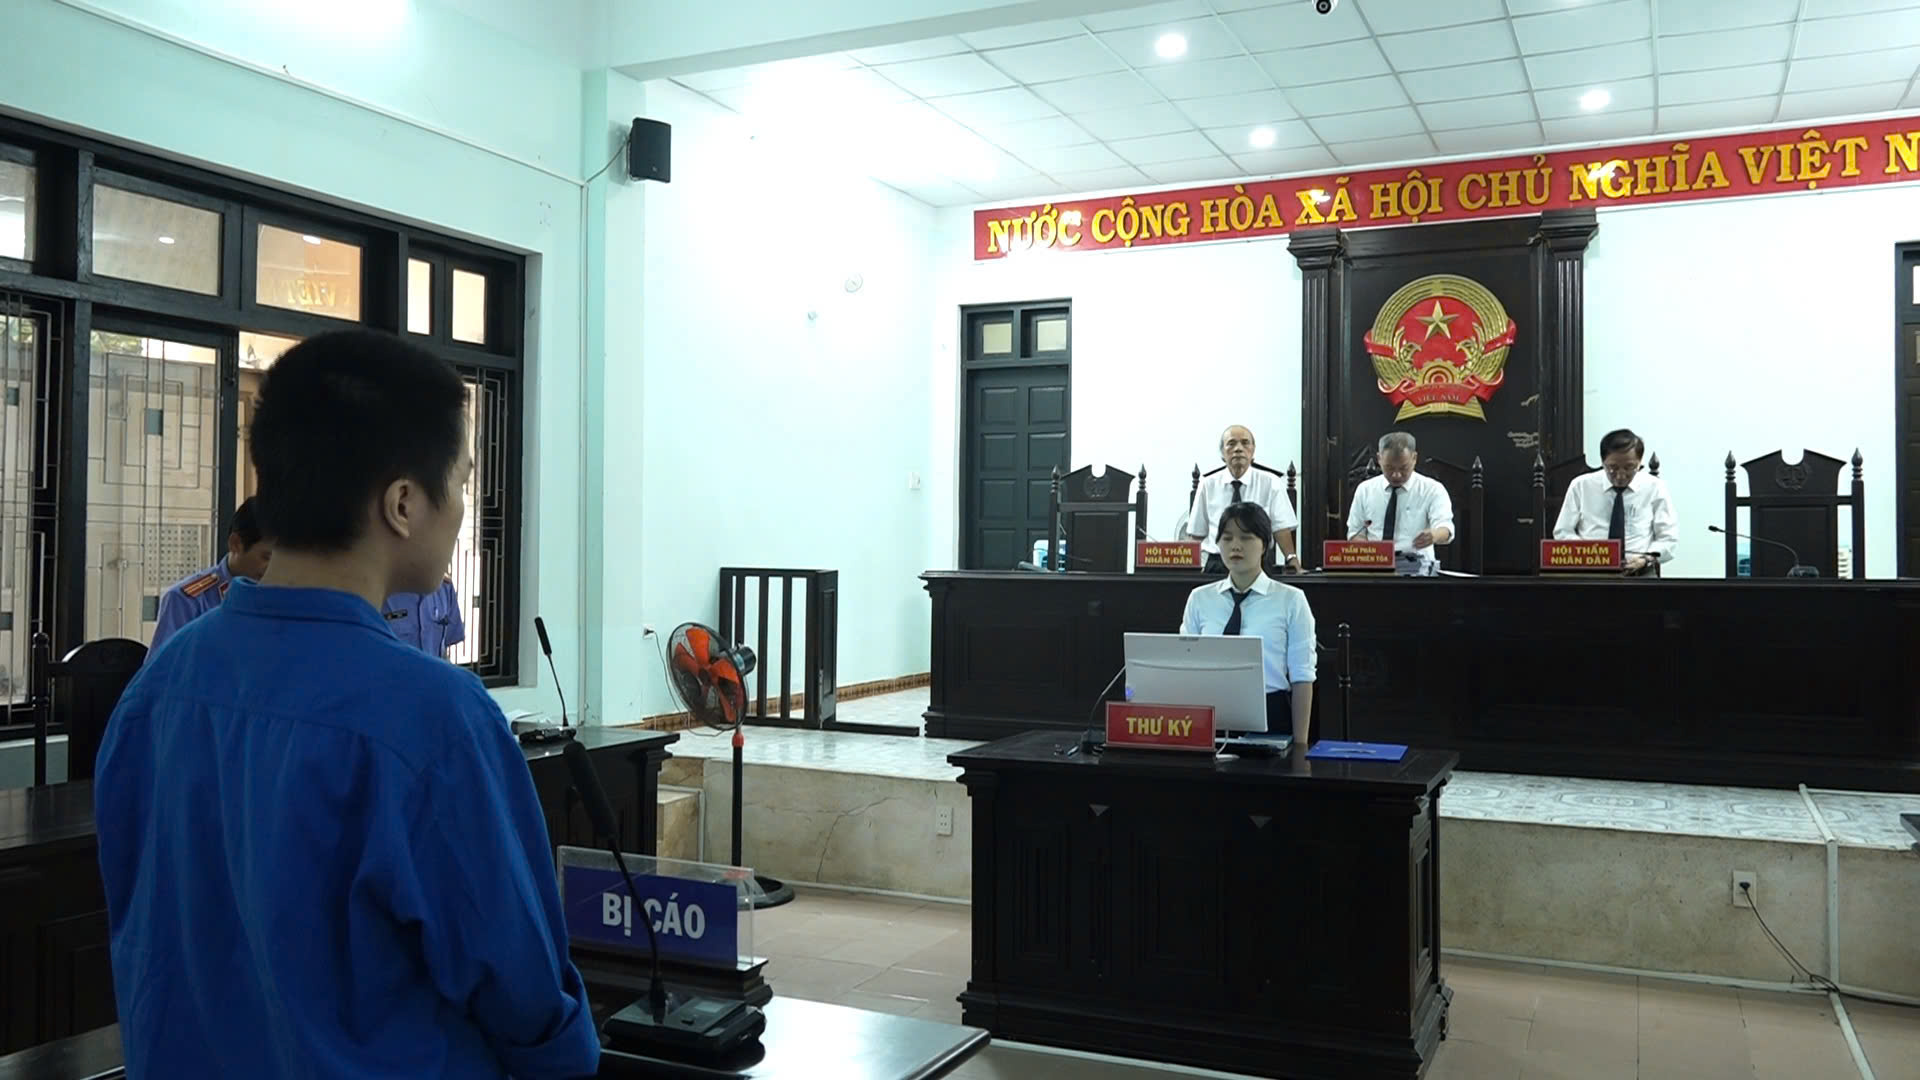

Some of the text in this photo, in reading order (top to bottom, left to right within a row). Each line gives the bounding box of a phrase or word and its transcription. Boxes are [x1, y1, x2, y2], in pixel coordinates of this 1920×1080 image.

[987, 203, 1083, 253] NƯỚC
[1091, 196, 1191, 248] CỘNG
[1201, 183, 1284, 234] HÒA
[1295, 176, 1357, 225] XÃ
[1369, 170, 1444, 223] HỘI
[1457, 153, 1553, 211] CHỦ
[1568, 143, 1730, 201] NGHĨA
[1738, 129, 1869, 191] VIỆT
[1145, 546, 1162, 556] HỘI
[1551, 545, 1572, 555] HỘI
[1144, 556, 1193, 564] NHÂN DÂN
[1551, 556, 1610, 565] NHÂN DÂN
[1126, 715, 1193, 737] THƯ KÝ
[602, 892, 706, 940] BỊ CÁO
